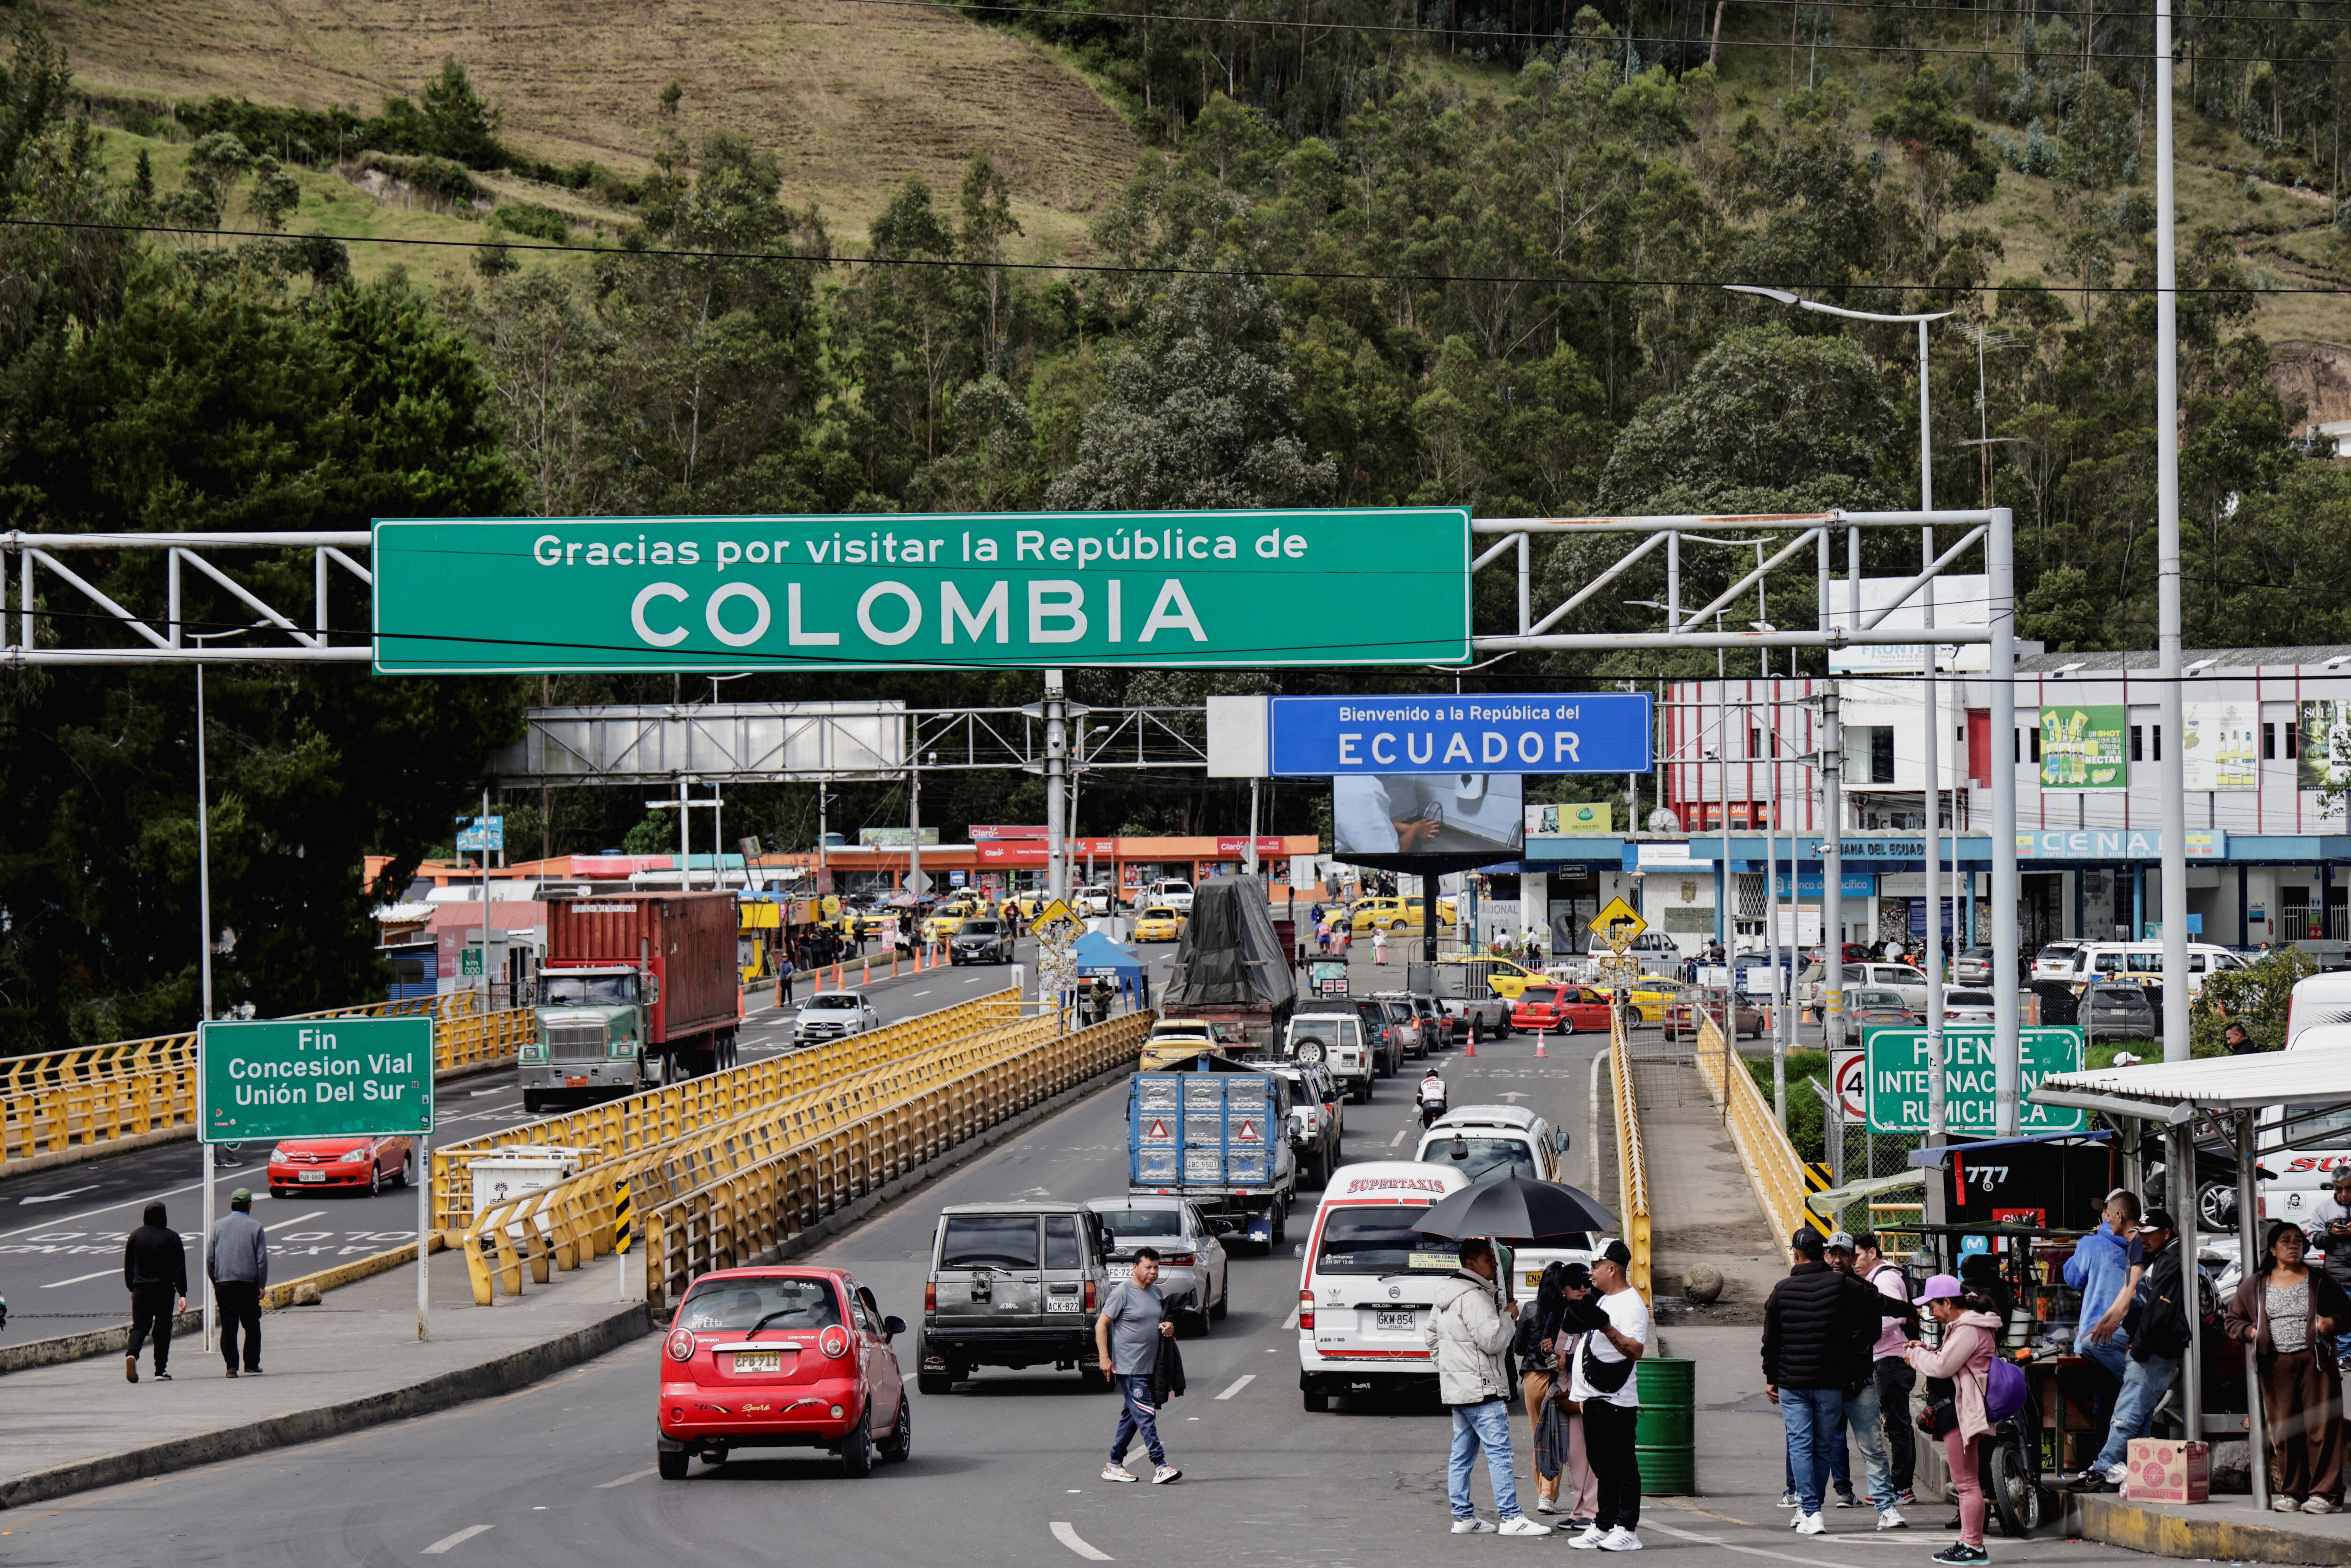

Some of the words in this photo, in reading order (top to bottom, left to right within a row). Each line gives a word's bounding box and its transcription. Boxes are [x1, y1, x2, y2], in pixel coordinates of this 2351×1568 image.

[534, 534, 700, 566] Gracias
[718, 541, 790, 572] por
[806, 532, 945, 563] visitar
[963, 531, 997, 561] la
[1017, 528, 1236, 570] República
[1255, 528, 1308, 558] de
[631, 578, 1208, 647] COLOMBIA
[1339, 706, 1430, 721] Bienvenido
[1435, 709, 1444, 720] a
[1450, 706, 1464, 720] la
[1470, 705, 1550, 723] República
[1556, 705, 1579, 719] del
[2304, 707, 2326, 718] 801
[1339, 731, 1580, 765] ECUADOR
[2085, 756, 2122, 764] NECTAR
[1868, 843, 1886, 855] DEL
[1890, 843, 1926, 855] ECUAD
[2042, 833, 2162, 851] CENA
[1788, 880, 1815, 890] Bnco
[465, 966, 481, 975] 000
[299, 1029, 337, 1050] Fin
[1913, 1037, 2035, 1065] PUENE
[229, 1056, 361, 1079] Concesion
[368, 1052, 412, 1074] Vial
[236, 1082, 307, 1105] Unión
[316, 1081, 355, 1103] Del
[363, 1079, 405, 1101] Sur
[1902, 1100, 2048, 1123] RUICHCA
[1965, 1166, 2009, 1183] 777
[1347, 1178, 1446, 1194] SUPERTAXIS
[1048, 1302, 1079, 1312] ACK-822
[742, 1403, 771, 1412] Spark
